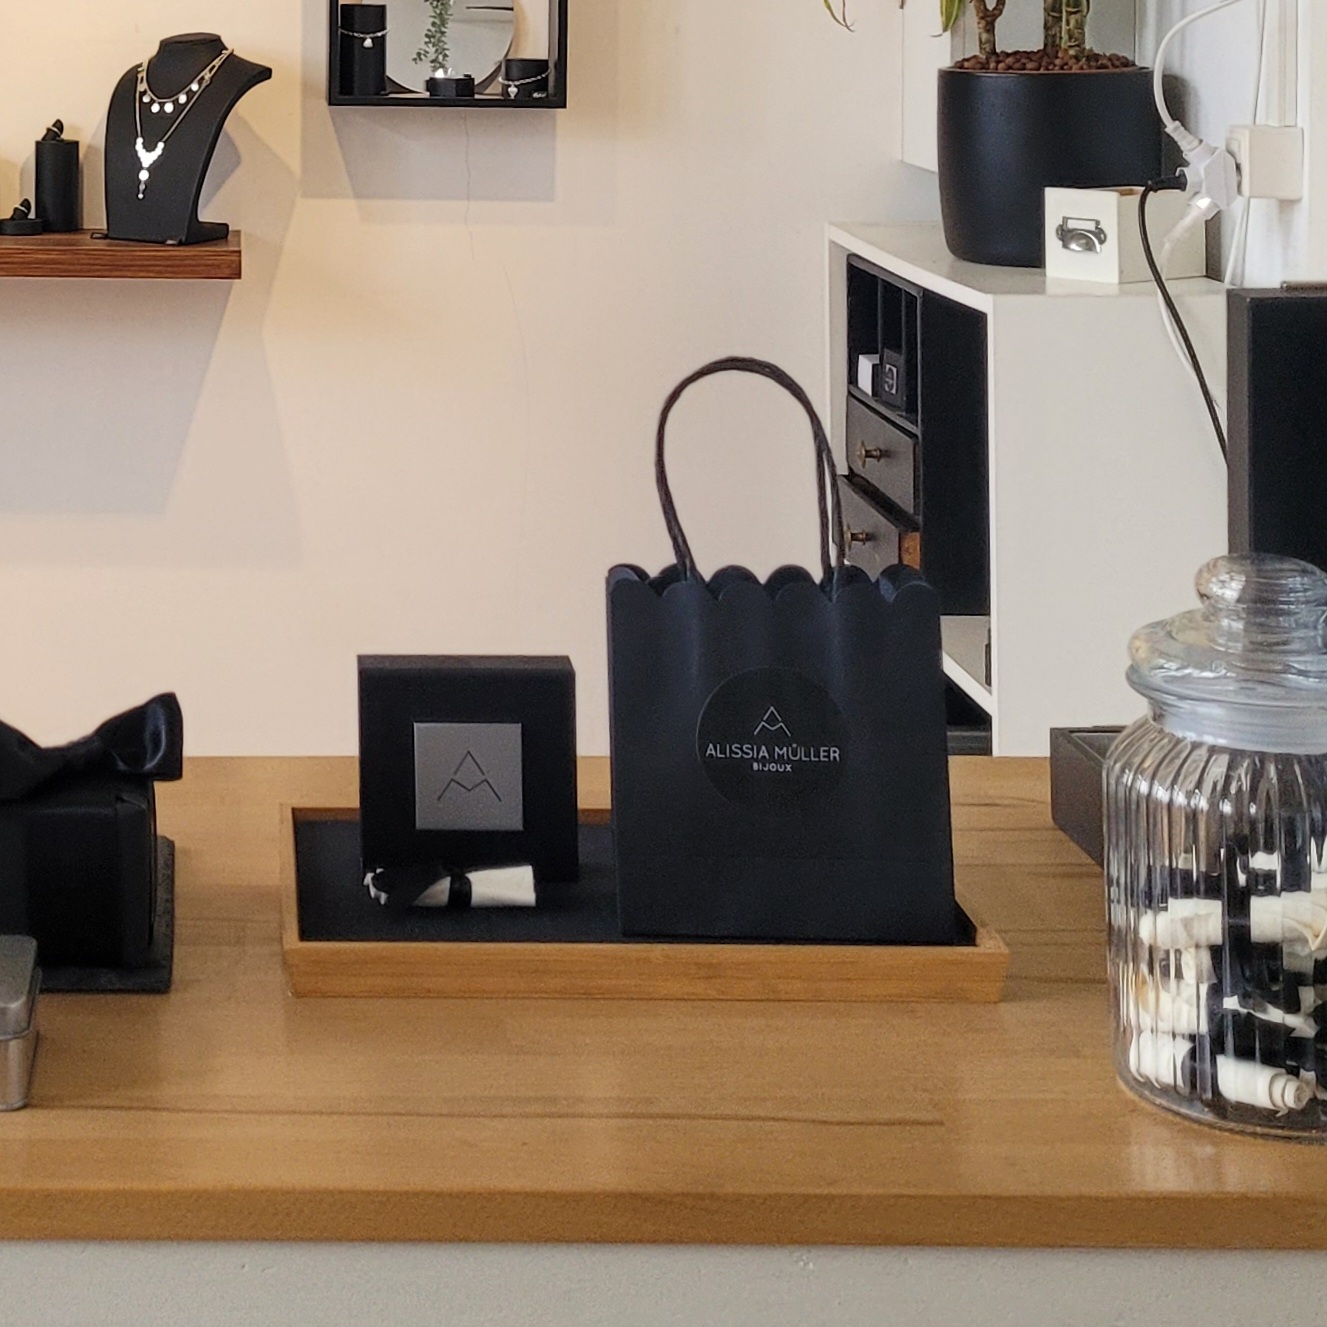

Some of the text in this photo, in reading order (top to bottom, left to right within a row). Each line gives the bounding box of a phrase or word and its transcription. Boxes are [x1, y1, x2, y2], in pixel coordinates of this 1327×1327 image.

[705, 742, 841, 762] ALISSIA MÜLLER
[752, 762, 793, 772] BIJOUX
